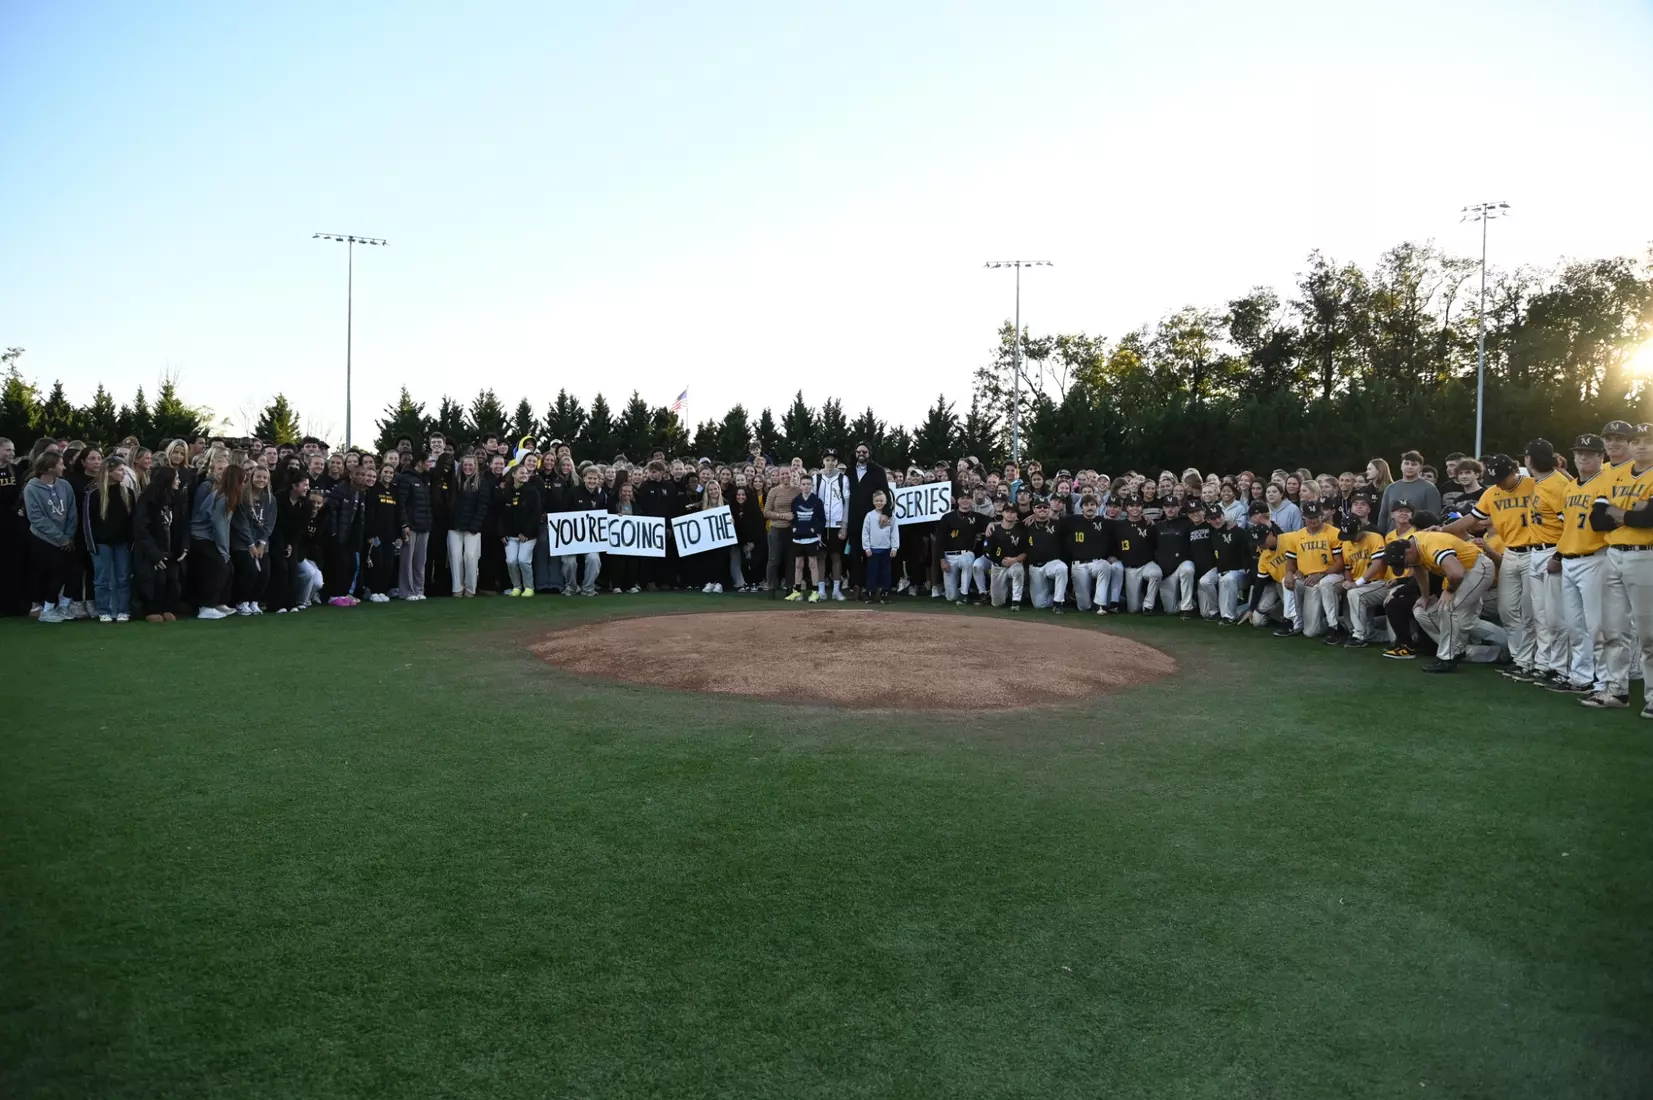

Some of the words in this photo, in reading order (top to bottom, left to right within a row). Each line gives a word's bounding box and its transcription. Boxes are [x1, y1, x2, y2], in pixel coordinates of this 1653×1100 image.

[895, 487, 950, 519] SERIES
[549, 513, 608, 549] YOU'RE
[673, 519, 701, 549] TO
[703, 512, 735, 542] THE
[1577, 513, 1586, 529] 7
[608, 518, 664, 550] GOING
[1074, 531, 1085, 543] 10
[1121, 539, 1130, 551] 13
[1300, 540, 1327, 552] VILLE
